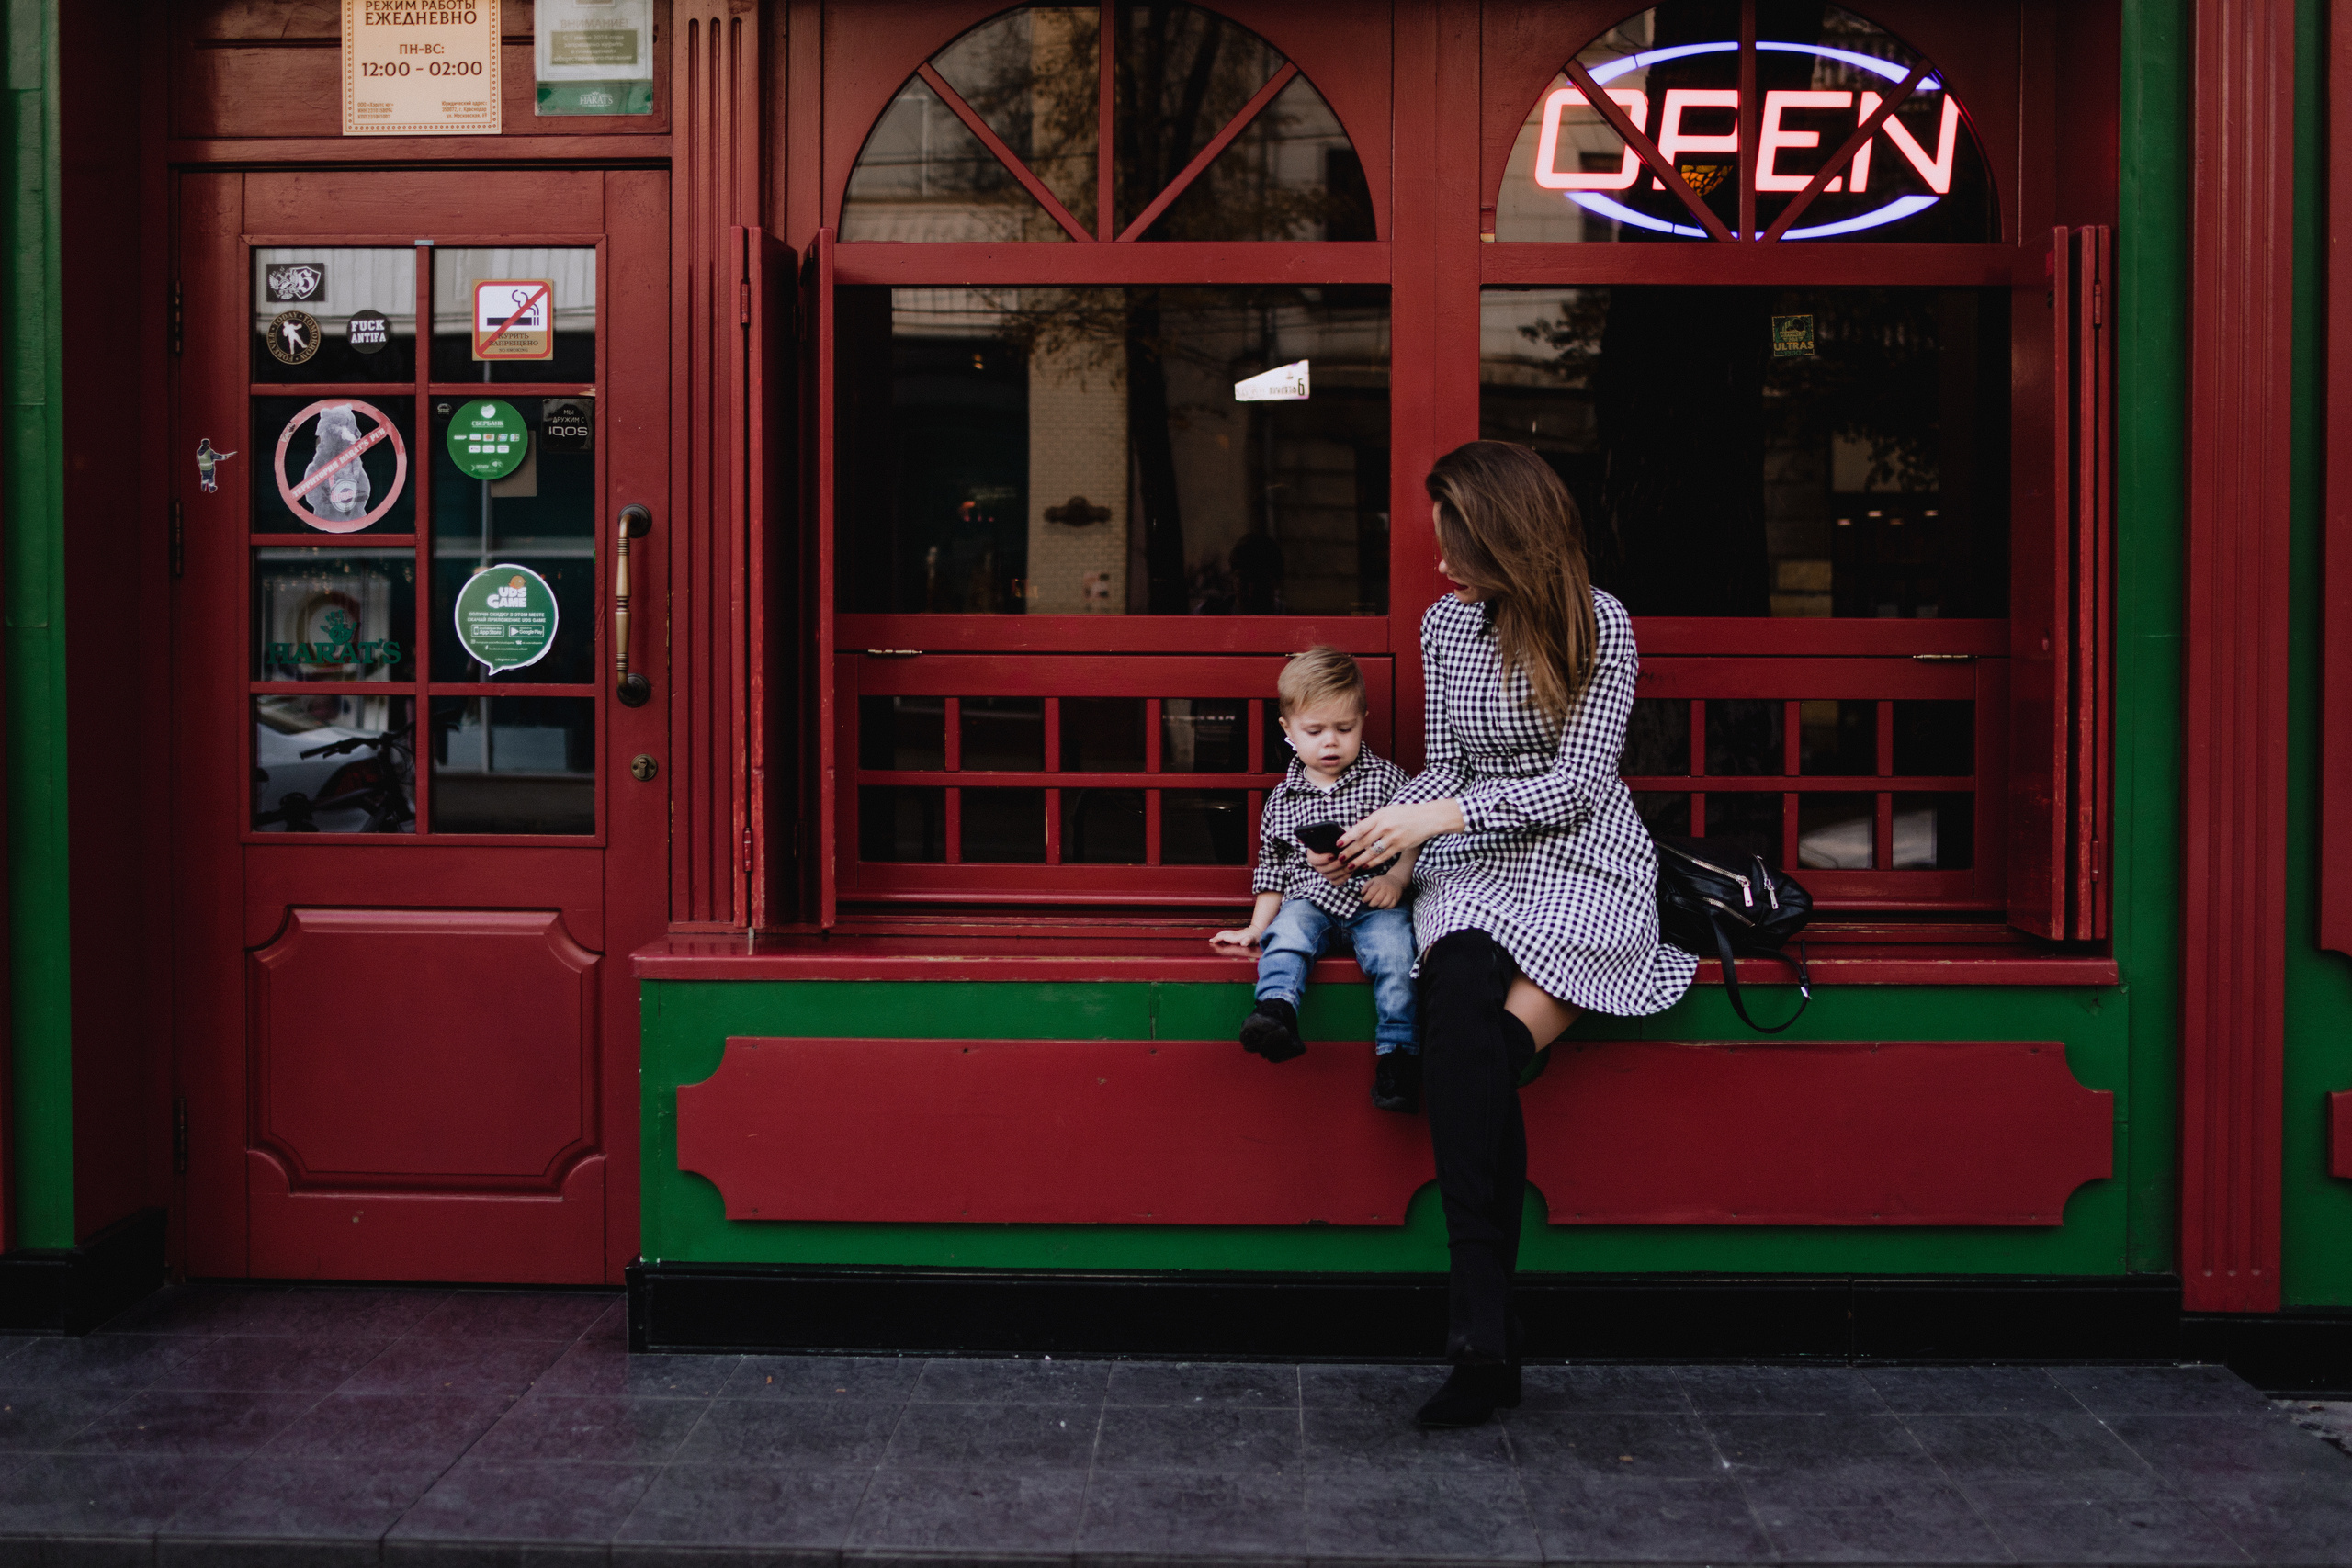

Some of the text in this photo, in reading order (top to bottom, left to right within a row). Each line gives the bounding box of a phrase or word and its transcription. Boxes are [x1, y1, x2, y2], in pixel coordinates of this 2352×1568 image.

[366, 0, 475, 11] РЕЖИМ РАБОТЫ
[366, 11, 478, 26] ЕЖЕДНЕВНО
[560, 18, 629, 28] ВНИМАНИЕ!
[399, 44, 445, 54] ПН-ВС:
[362, 62, 411, 76] 12:00
[429, 61, 482, 76] 02:00
[1534, 89, 1959, 194] OPEN
[273, 312, 297, 326] TODAY
[351, 320, 385, 332] FUCK
[300, 315, 318, 360] TOMORROW
[351, 333, 386, 344] ANTIFA
[269, 332, 294, 362] FOREVER
[1773, 341, 1814, 351] ULTRAS
[548, 426, 588, 437] IQOS
[292, 461, 339, 497] ТЕРРИТОРИЯ
[369, 427, 386, 442] PUB
[498, 586, 527, 598] UDS
[487, 593, 527, 608] GAME
[267, 638, 401, 664] HARAT'S
